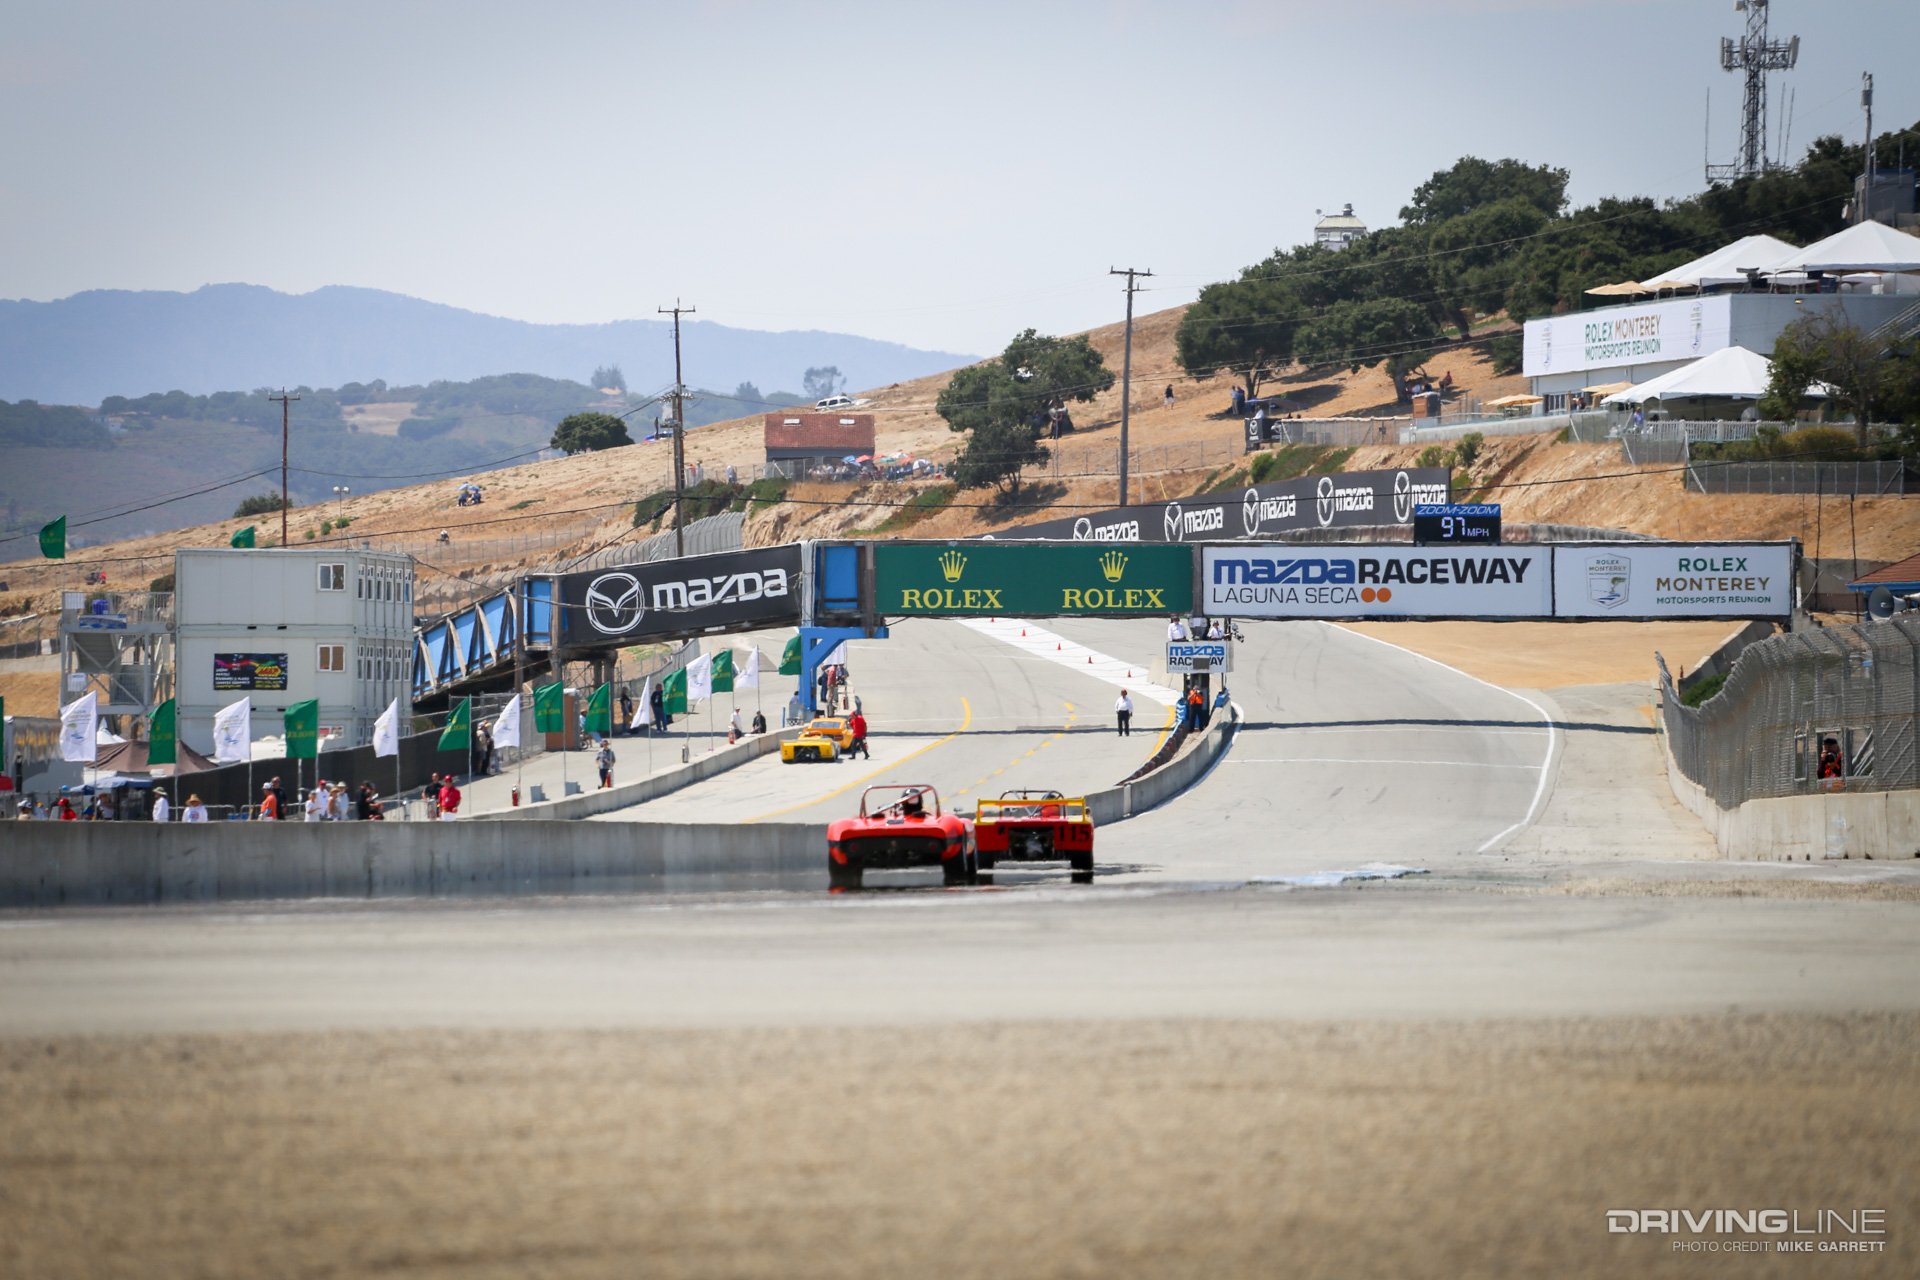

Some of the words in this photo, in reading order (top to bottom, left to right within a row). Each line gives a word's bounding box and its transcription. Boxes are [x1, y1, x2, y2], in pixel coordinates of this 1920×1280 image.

[1585, 320, 1614, 344] ROLEX
[1615, 314, 1661, 339] MONTEREY
[1585, 341, 1631, 361] MOTORSPORTS
[1632, 338, 1661, 356] REUNION
[1335, 486, 1374, 512] mazda
[1411, 483, 1447, 508] mazda
[1260, 493, 1296, 522] mazda
[1416, 505, 1500, 515] ZOOM-ZOOM
[1184, 506, 1224, 534] mazda
[1441, 516, 1466, 538] 97
[1467, 528, 1490, 537] MPH
[1678, 557, 1748, 572] ROLEX
[652, 568, 788, 612] mazda
[1656, 577, 1771, 592] MONTEREY
[900, 588, 1004, 609] ROLEX
[1062, 588, 1166, 609] ROLEX
[1213, 587, 1300, 604] LAGUNA
[1305, 587, 1359, 604] SECA
[1656, 596, 1727, 605] MOTORSPORTS
[1728, 595, 1771, 604] REUNION
[1169, 645, 1225, 656] mazda
[1169, 656, 1224, 666] RACAY
[1057, 824, 1090, 842] 115
